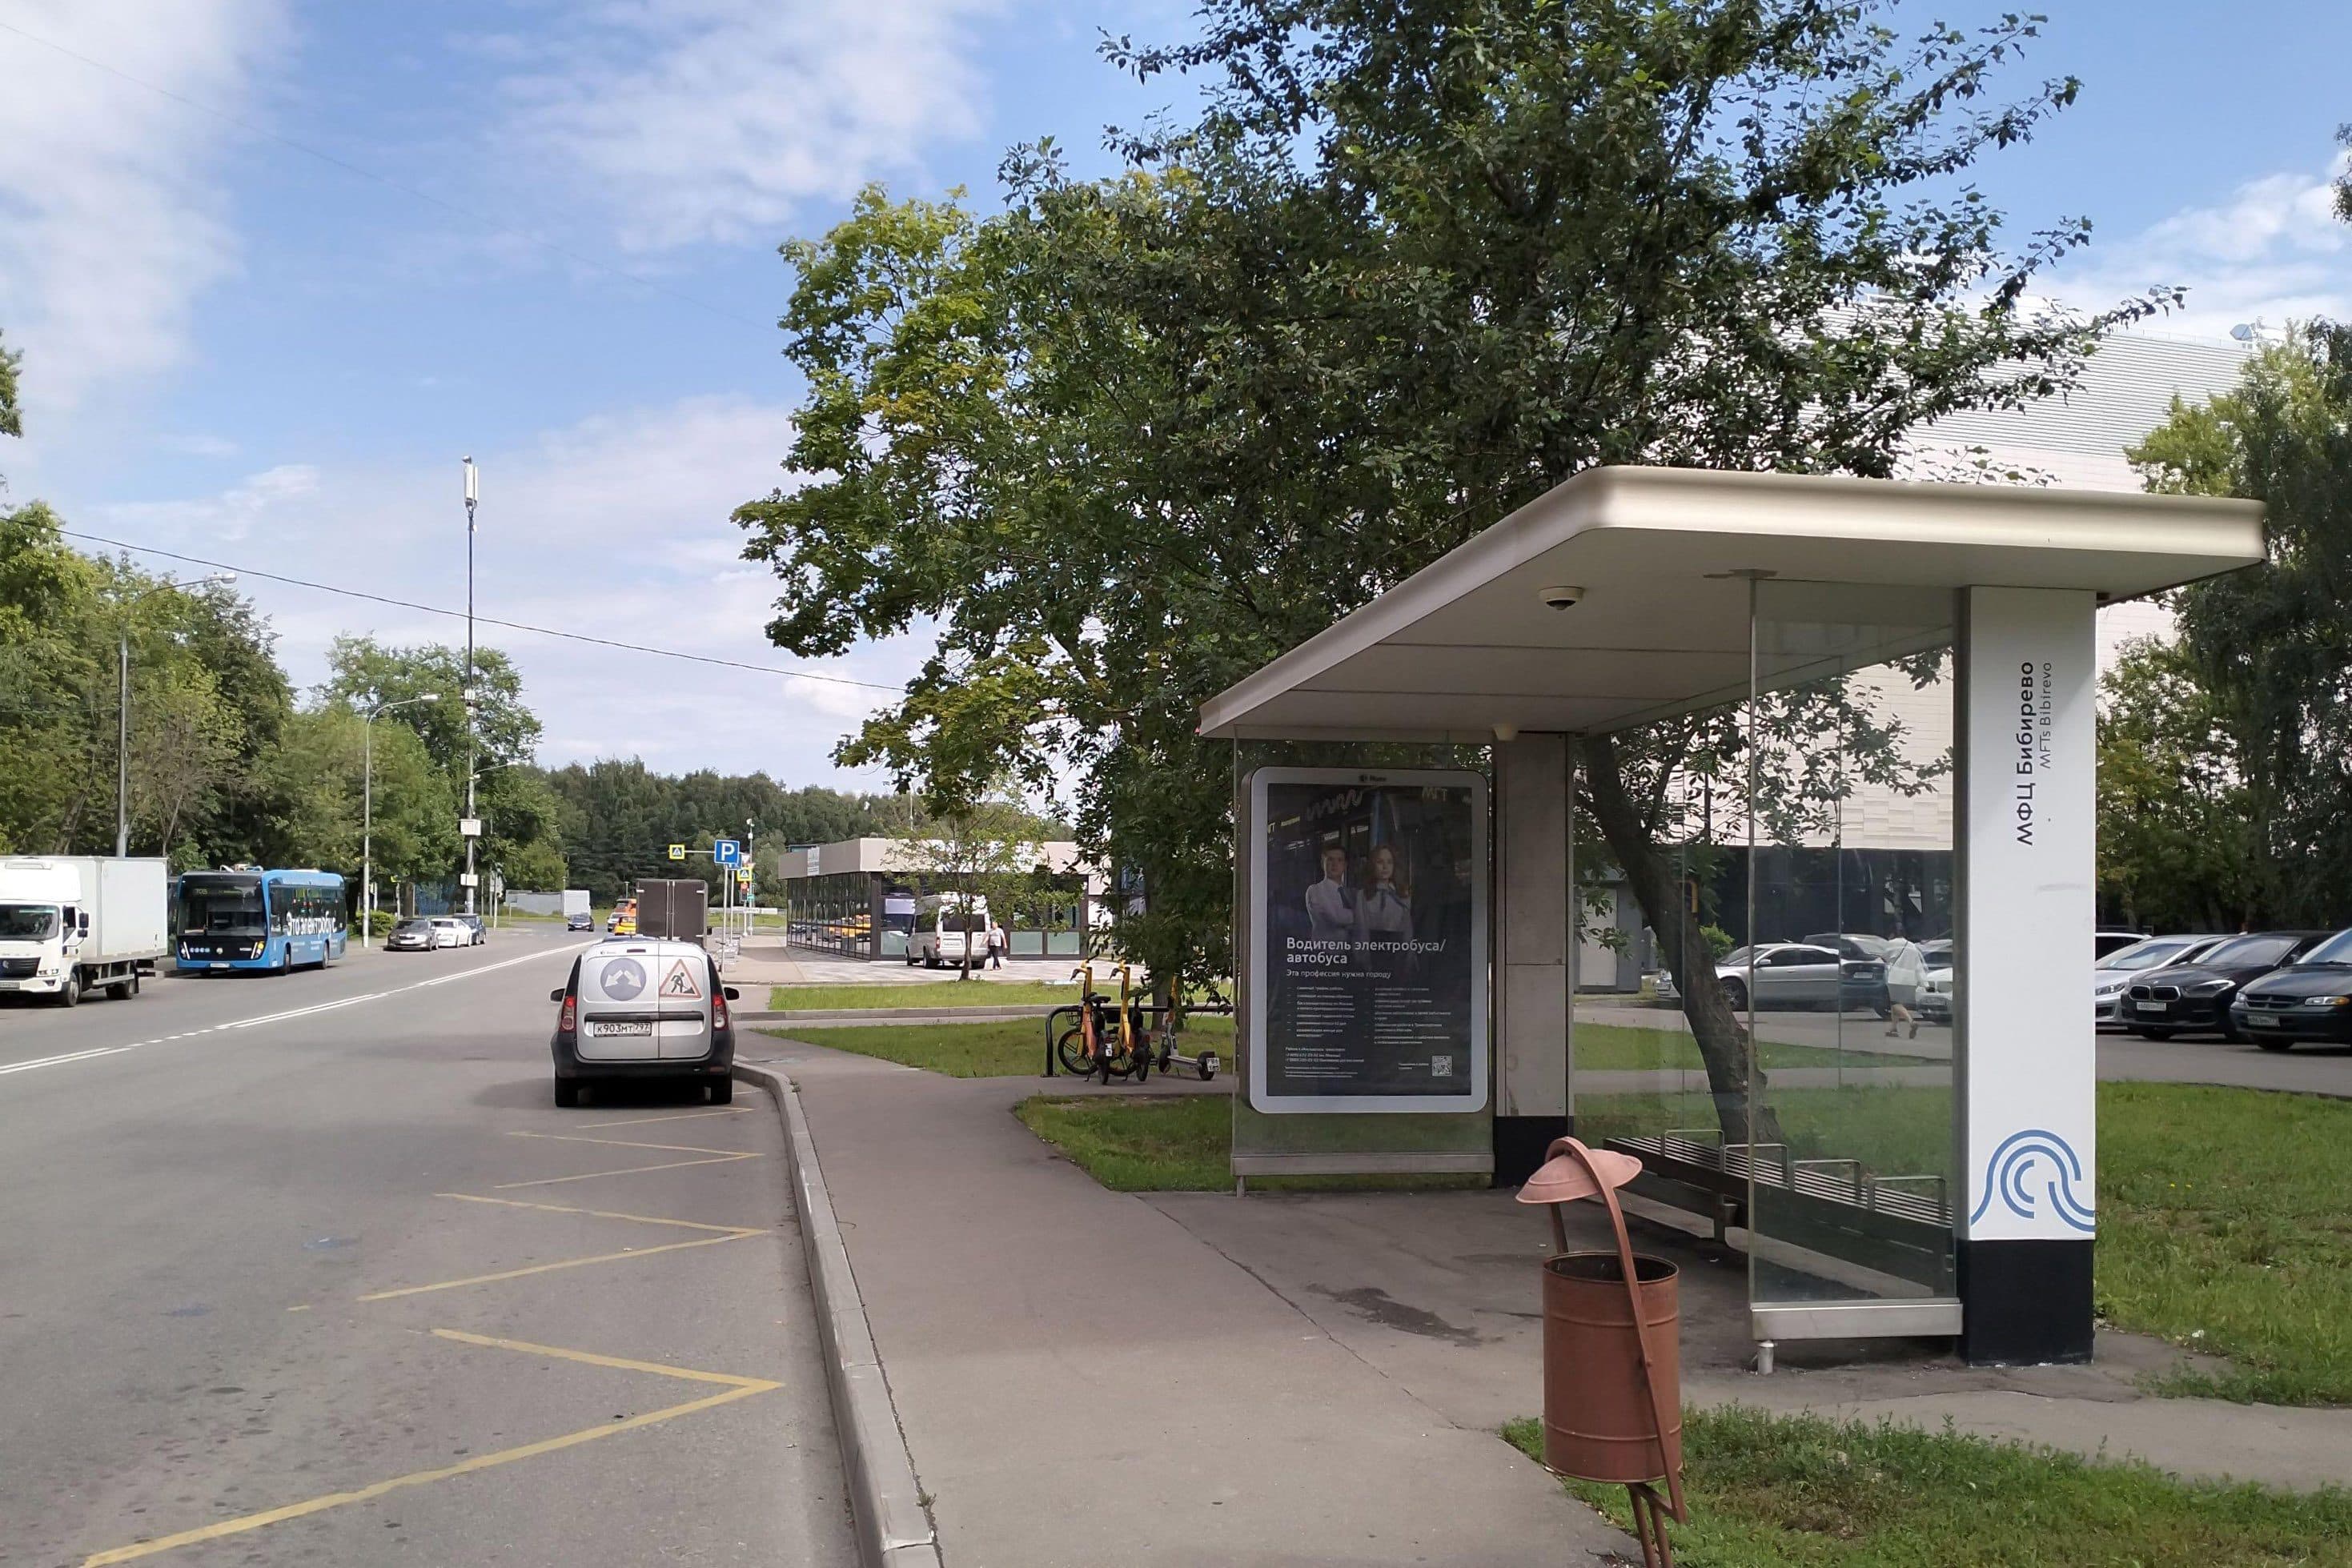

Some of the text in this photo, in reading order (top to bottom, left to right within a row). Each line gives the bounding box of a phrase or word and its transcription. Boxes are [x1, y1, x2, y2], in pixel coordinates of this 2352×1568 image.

[2040, 663, 2052, 769] MFTs Bibirevo
[2016, 662, 2037, 846] МФЦ Бибирево
[721, 843, 735, 861] P
[287, 912, 300, 936] Это
[1286, 937, 1447, 953] Водитель электробуса/
[1286, 952, 1347, 965] автобуса
